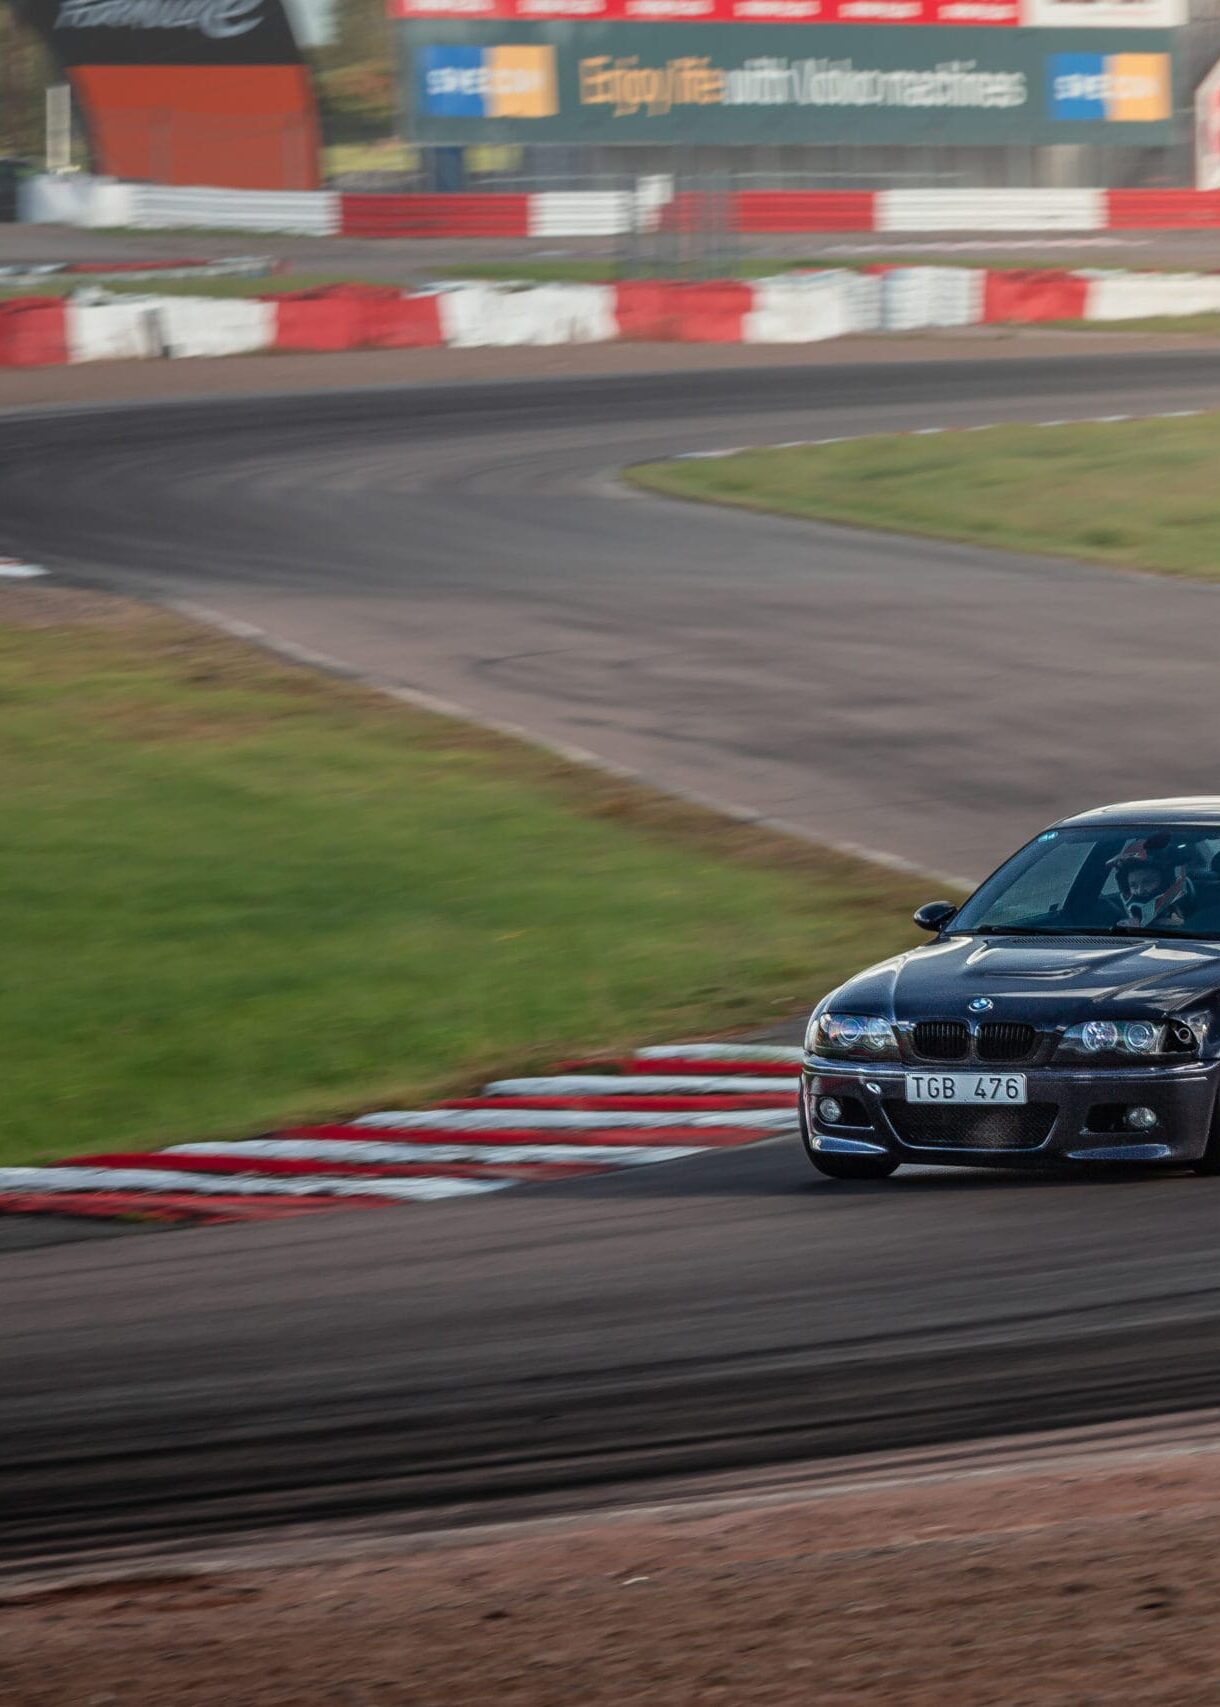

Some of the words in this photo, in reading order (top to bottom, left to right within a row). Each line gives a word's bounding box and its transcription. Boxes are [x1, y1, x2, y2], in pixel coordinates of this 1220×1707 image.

[579, 56, 671, 118] Enjoy
[665, 56, 726, 105] life
[722, 57, 793, 105] with
[878, 60, 1027, 108] machines
[911, 1076, 956, 1100] TGB
[973, 1076, 1019, 1100] 476
